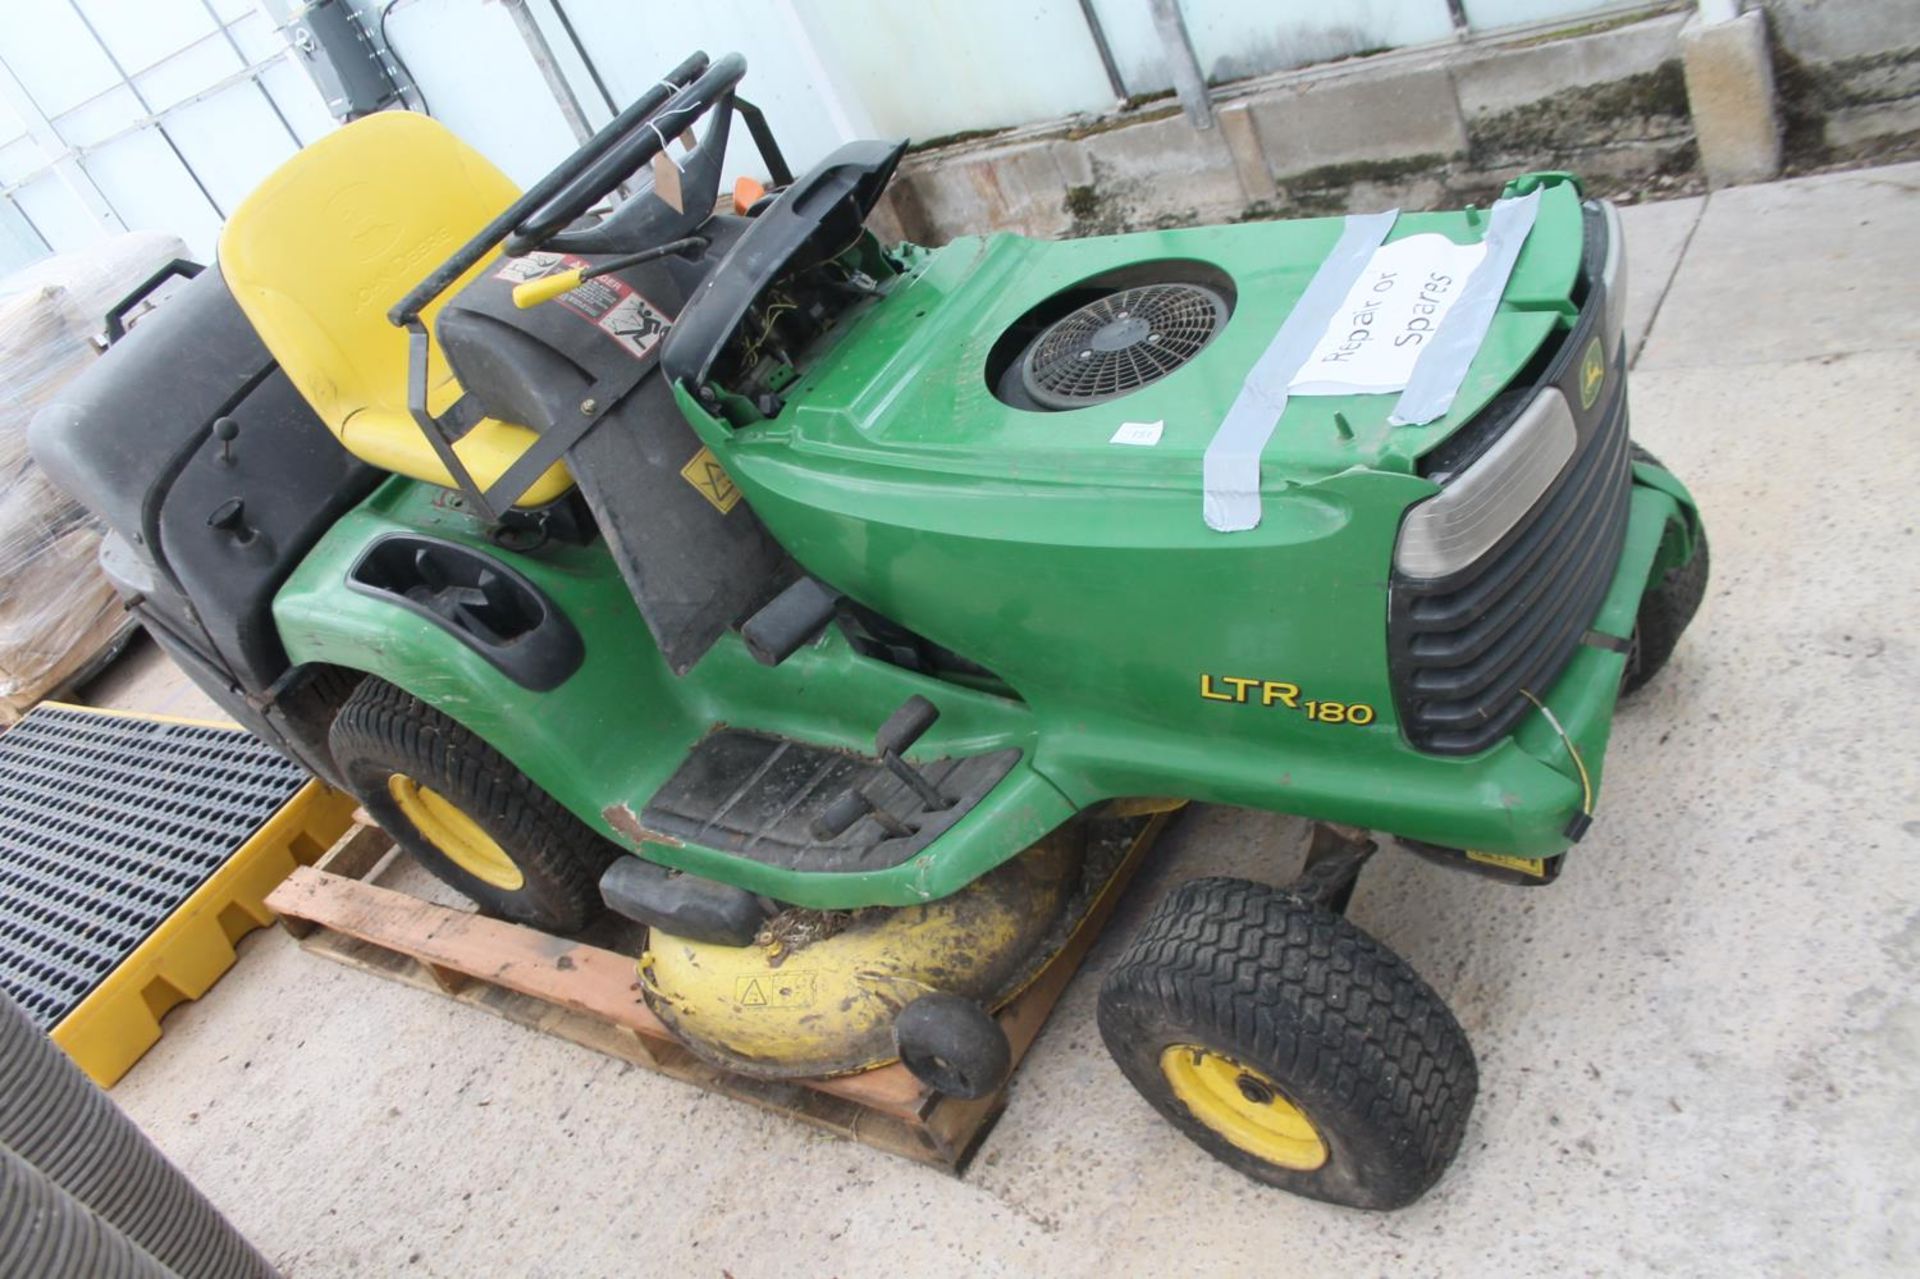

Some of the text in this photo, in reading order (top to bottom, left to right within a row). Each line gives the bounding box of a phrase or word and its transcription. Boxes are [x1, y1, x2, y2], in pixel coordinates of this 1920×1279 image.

[1321, 301, 1382, 362] Repair
[1394, 272, 1453, 347] Spares
[1201, 674, 1377, 725] LTR 180
